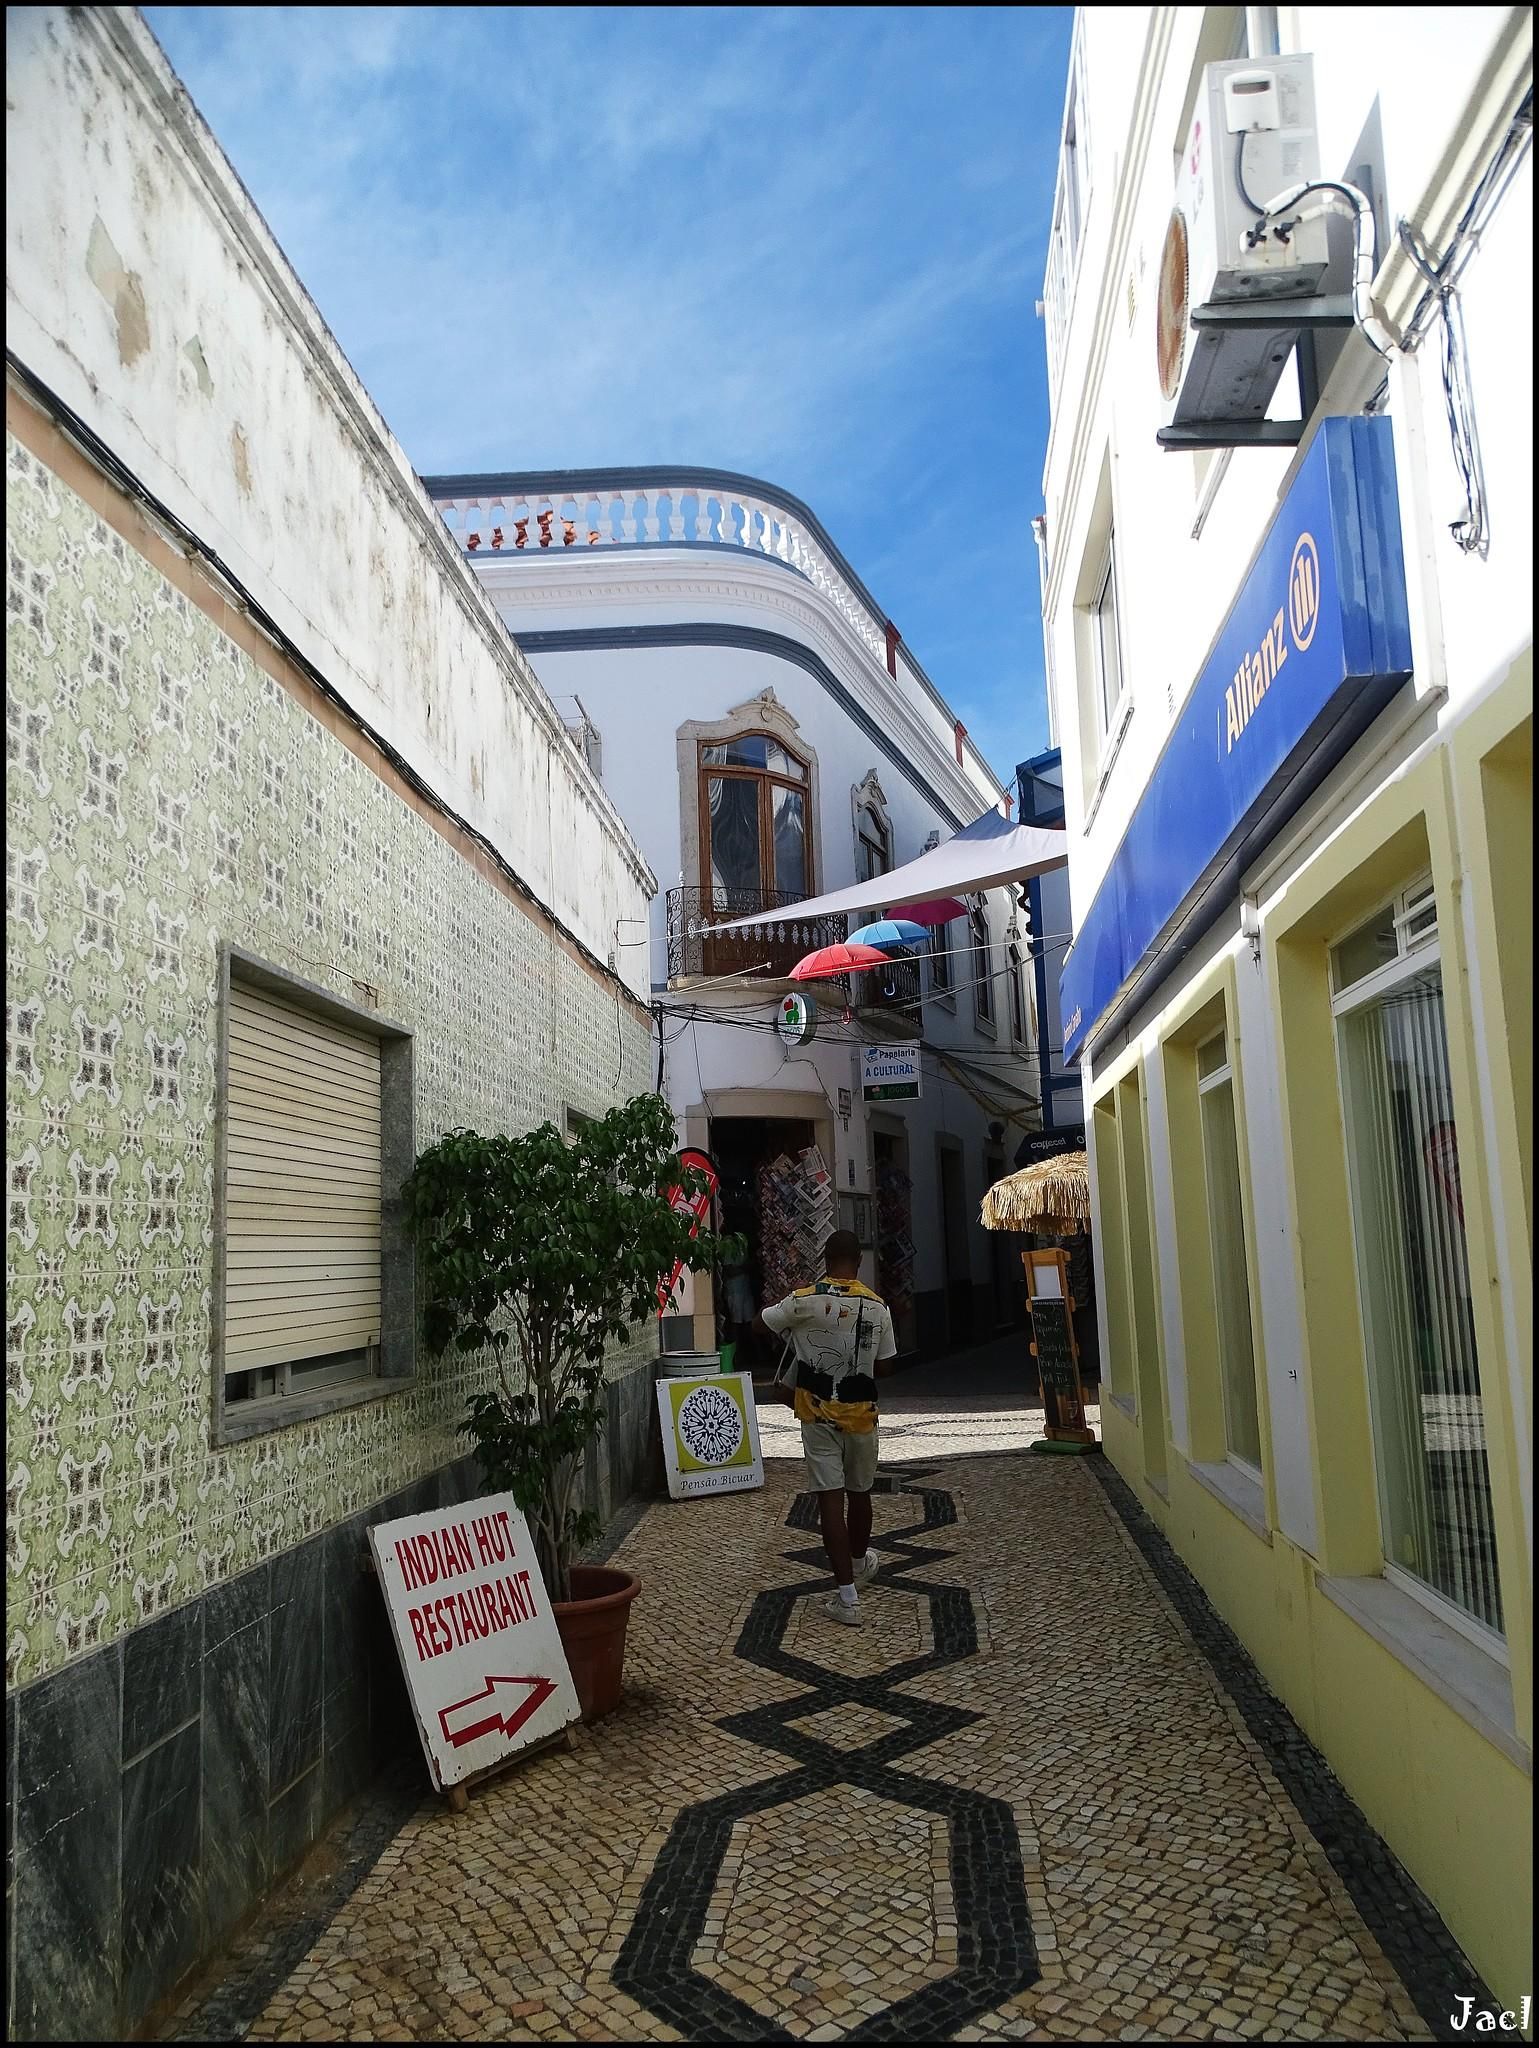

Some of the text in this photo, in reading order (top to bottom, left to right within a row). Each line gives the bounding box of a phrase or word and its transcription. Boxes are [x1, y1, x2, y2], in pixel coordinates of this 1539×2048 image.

[1225, 605, 1288, 755] Allianz
[865, 1064, 915, 1077] A CULTURAL
[879, 1048, 916, 1060] Papelaria
[680, 1473, 755, 1491] Pensão Bicuar
[394, 1511, 516, 1592] INDIAN HUT
[407, 1570, 538, 1662] RESTAURANT
